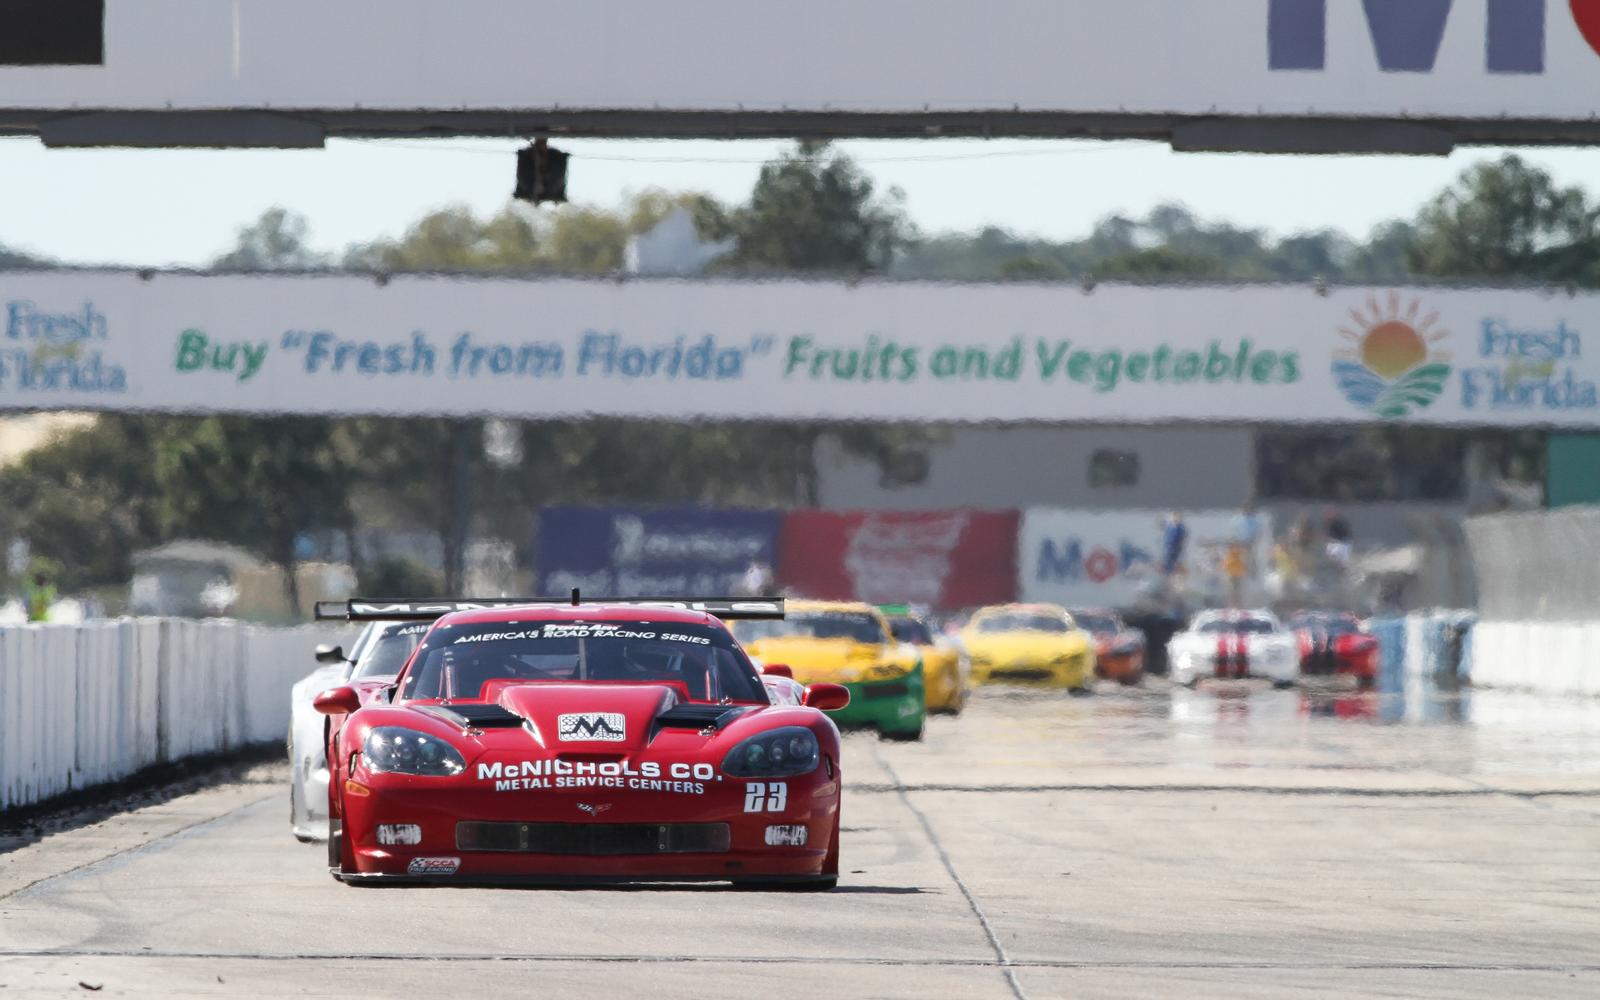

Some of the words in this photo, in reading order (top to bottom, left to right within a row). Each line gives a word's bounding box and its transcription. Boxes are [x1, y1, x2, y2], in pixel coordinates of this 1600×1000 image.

[6, 298, 108, 340] Fresh
[1479, 316, 1582, 358] Fresh
[175, 328, 267, 382] Buy
[446, 330, 564, 378] from
[783, 332, 920, 384] Fruits
[928, 334, 1026, 382] and
[1035, 335, 1301, 393] Vegetables
[454, 630, 539, 645] AMERICA'S
[544, 630, 590, 639] ROAD
[593, 630, 656, 640] RACING
[660, 632, 711, 646] SERIES
[477, 759, 660, 780] McNICHOLS
[671, 762, 723, 782] CO.
[495, 777, 551, 792] METAL
[555, 776, 625, 789] SERVICE
[629, 777, 705, 795] CENTERS
[744, 781, 787, 813] 23
